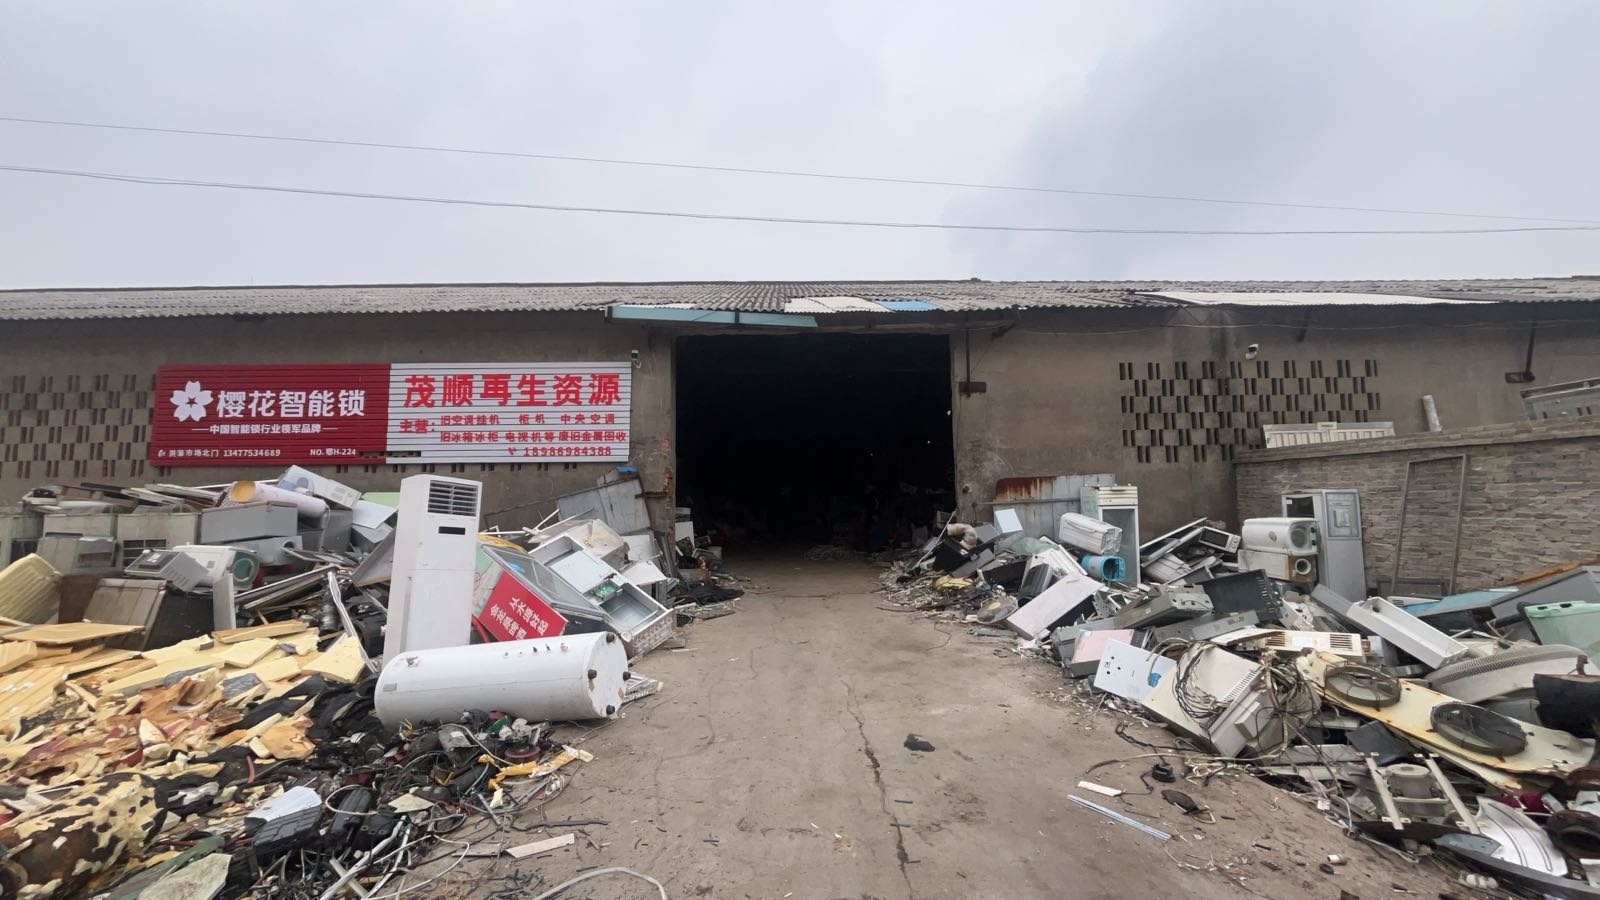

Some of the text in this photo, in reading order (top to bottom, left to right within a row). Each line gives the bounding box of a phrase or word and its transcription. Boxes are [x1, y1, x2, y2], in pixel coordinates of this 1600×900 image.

[403, 373, 622, 408] 茂顺再生资源
[216, 390, 366, 418] 樱花智能锁
[440, 413, 615, 426] 旧空调挂机 柜机 中央空调
[209, 423, 322, 435] 中国智能锁行业领军品牌
[440, 431, 499, 443] 旧冰箱冰柜
[223, 449, 281, 457] 13477534689
[523, 446, 612, 457] 18986984388
[490, 603, 527, 640] 金龙泉啤酒
[509, 596, 550, 636] 从水源好起
